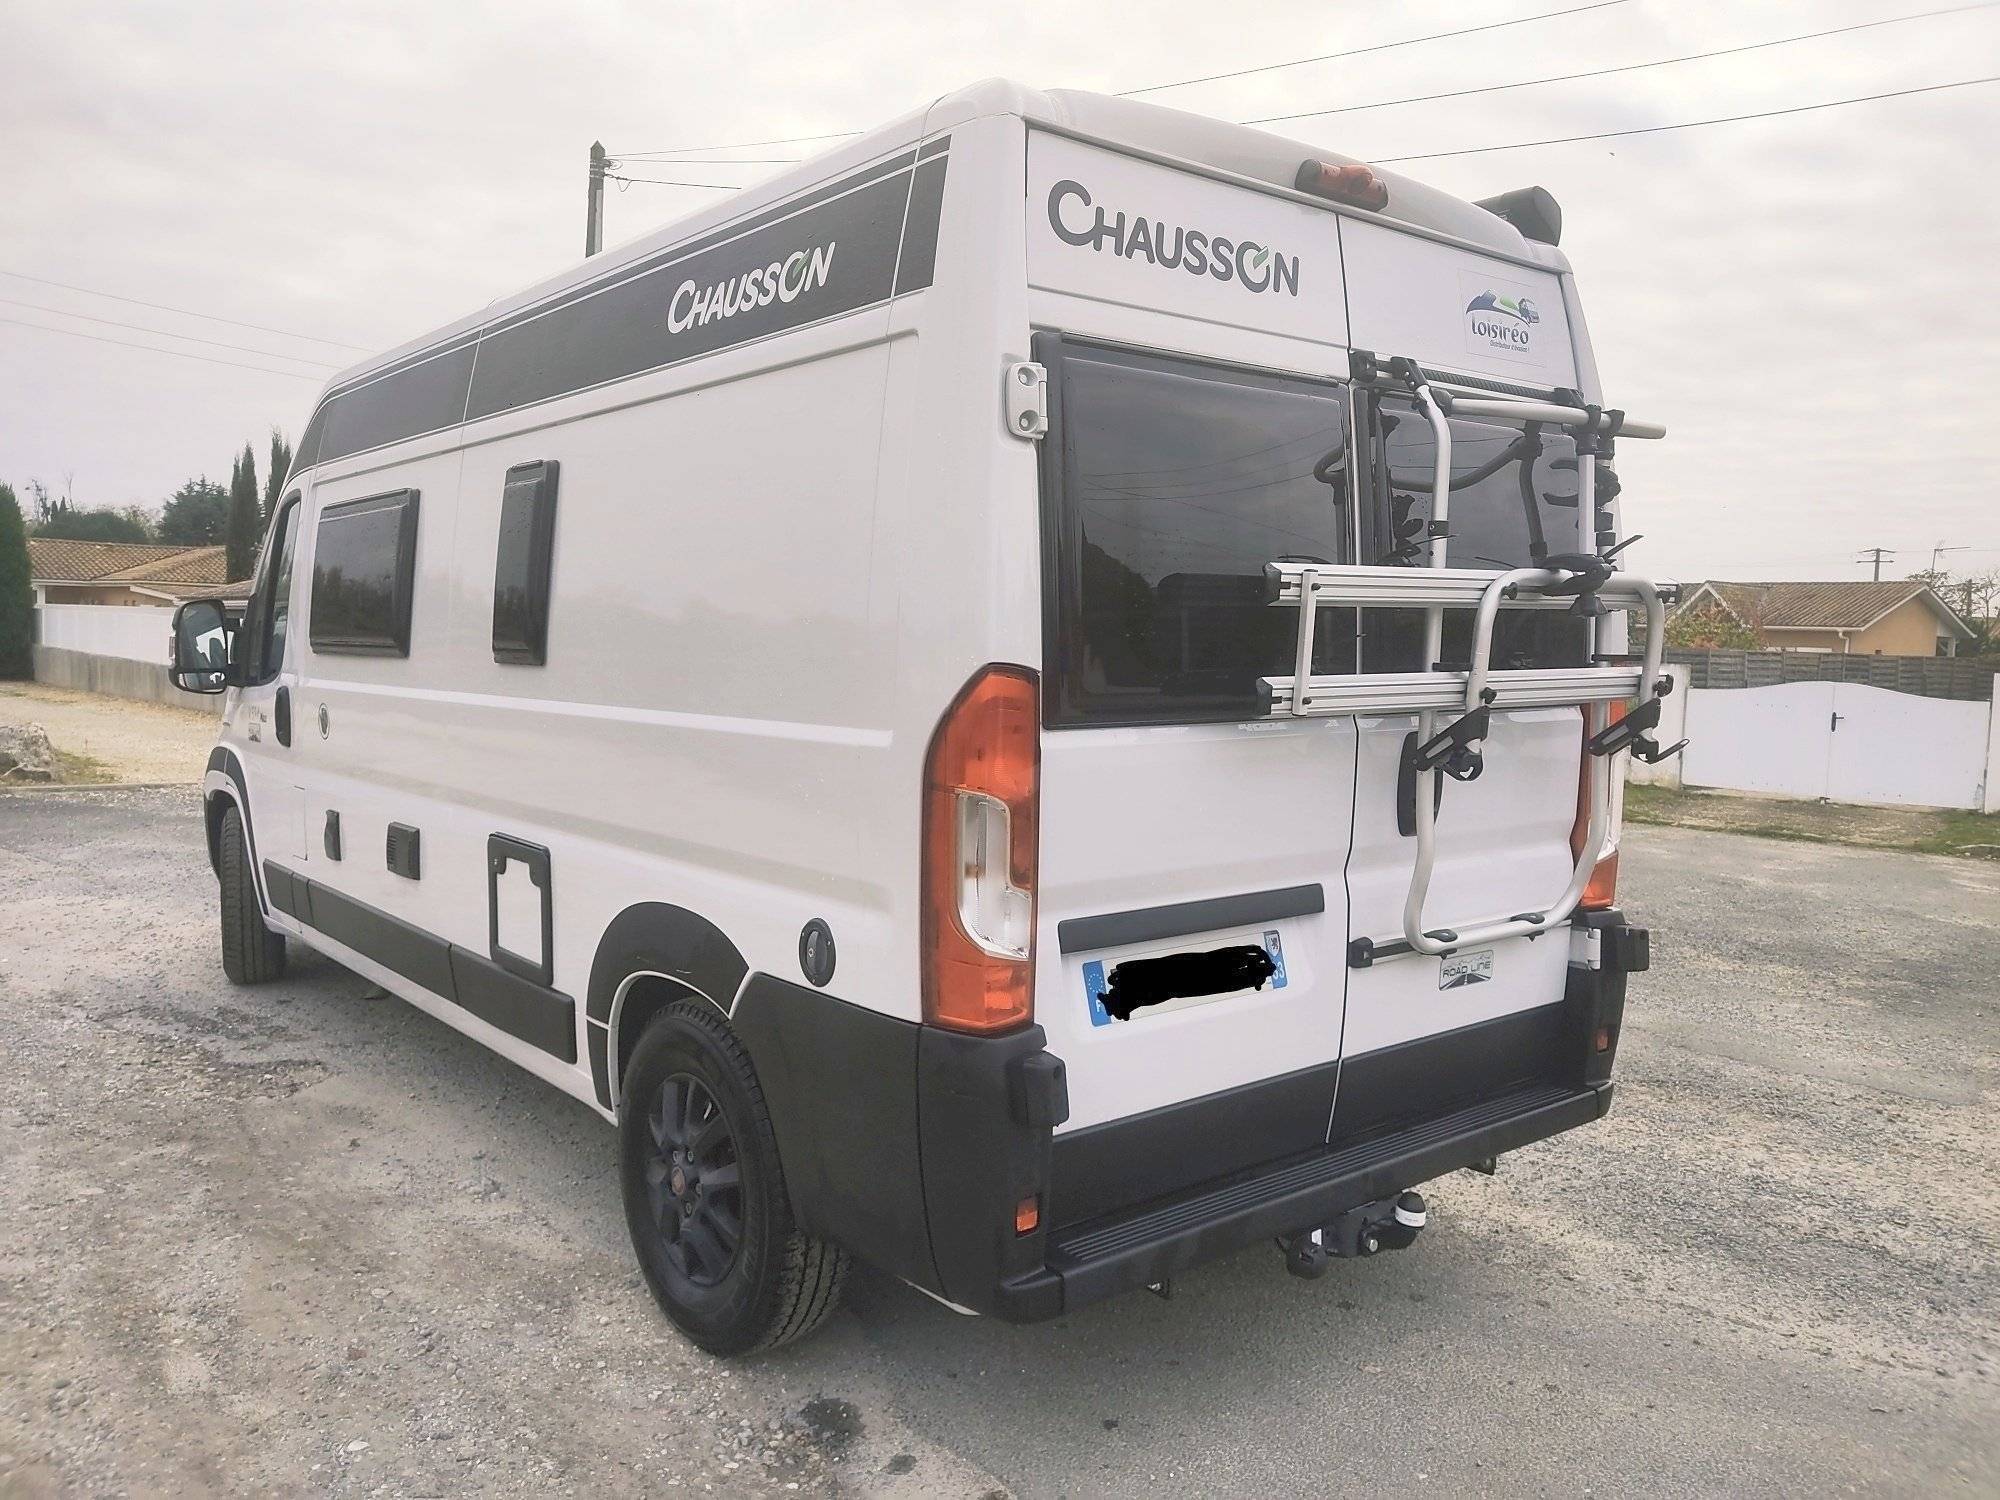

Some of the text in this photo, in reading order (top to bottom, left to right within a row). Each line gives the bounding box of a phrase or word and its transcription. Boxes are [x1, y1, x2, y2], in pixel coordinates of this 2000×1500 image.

[1047, 179, 1300, 297] CHAUSSON
[667, 241, 836, 334] CHAUSSON
[1443, 960, 1492, 978] ROAD LINE
